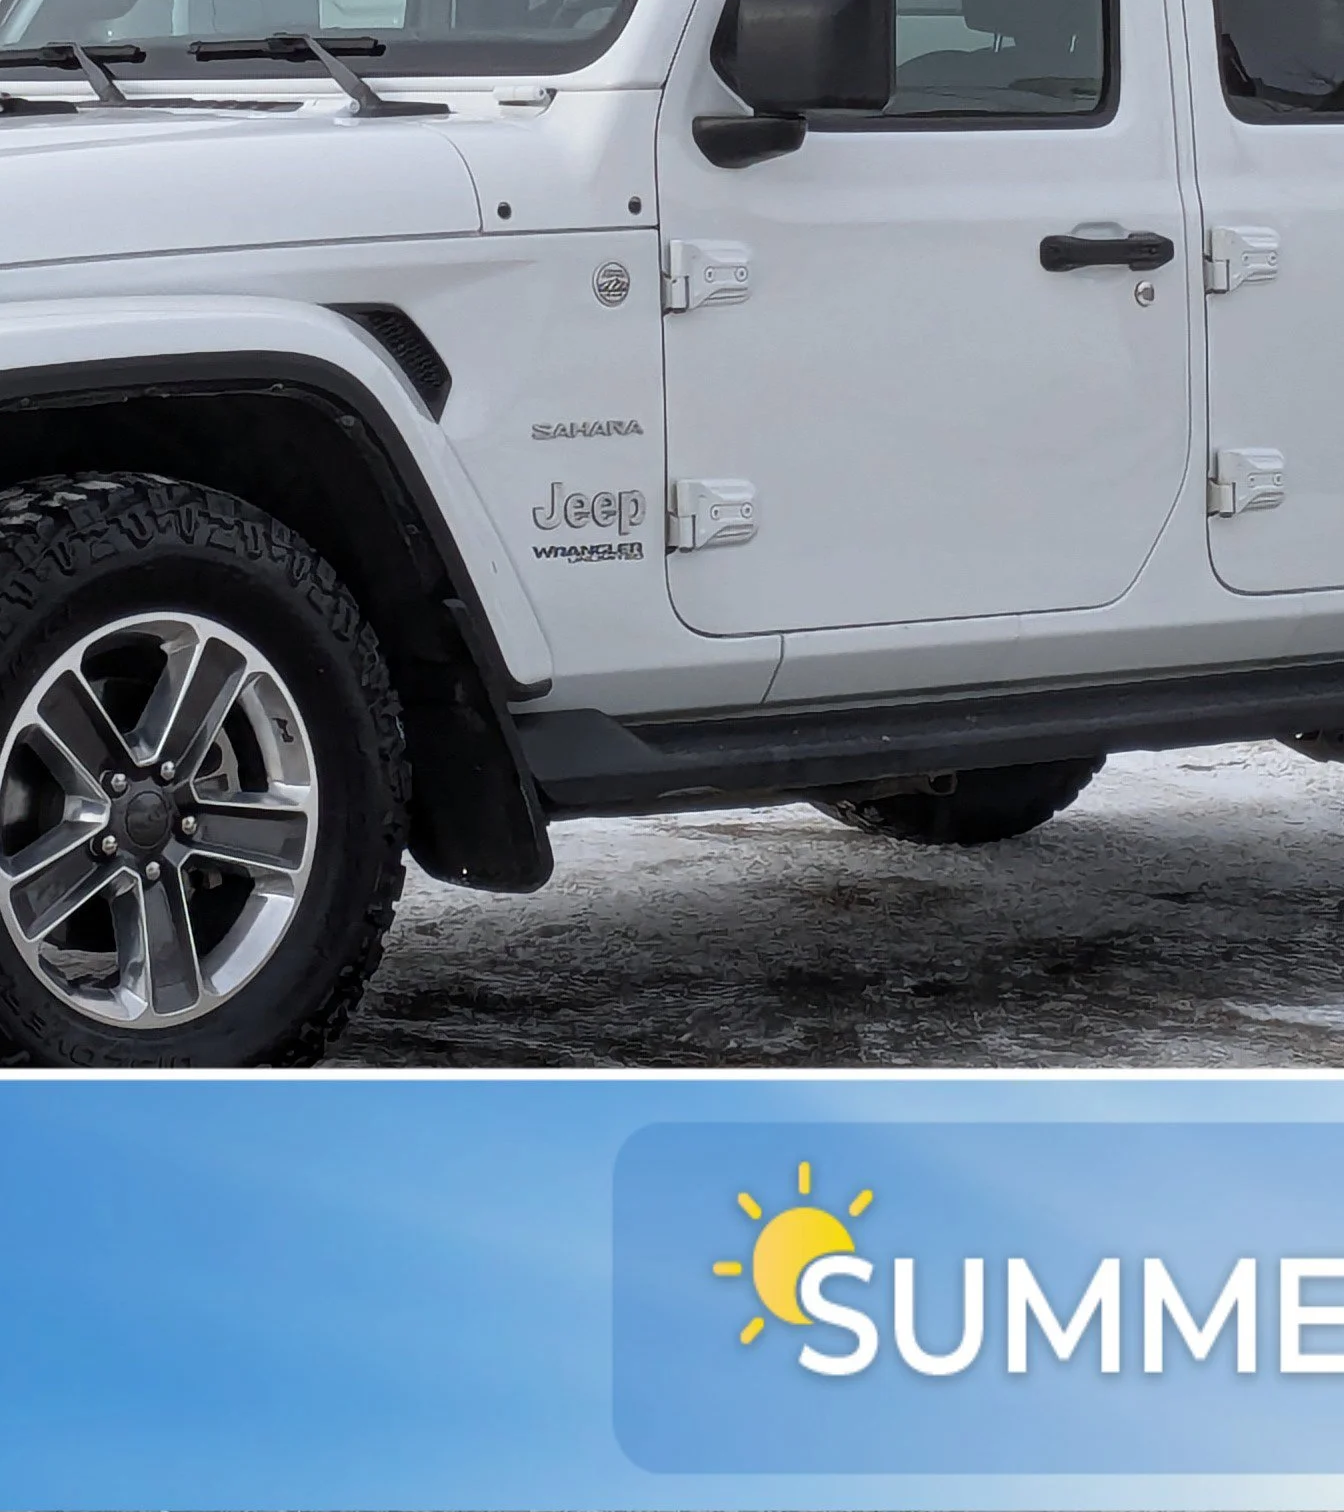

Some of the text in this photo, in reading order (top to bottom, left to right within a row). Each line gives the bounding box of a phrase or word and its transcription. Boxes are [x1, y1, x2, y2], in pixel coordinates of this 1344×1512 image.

[531, 420, 644, 440] SAHARA
[532, 482, 646, 536] Jeep
[532, 542, 643, 559] WRANGLER
